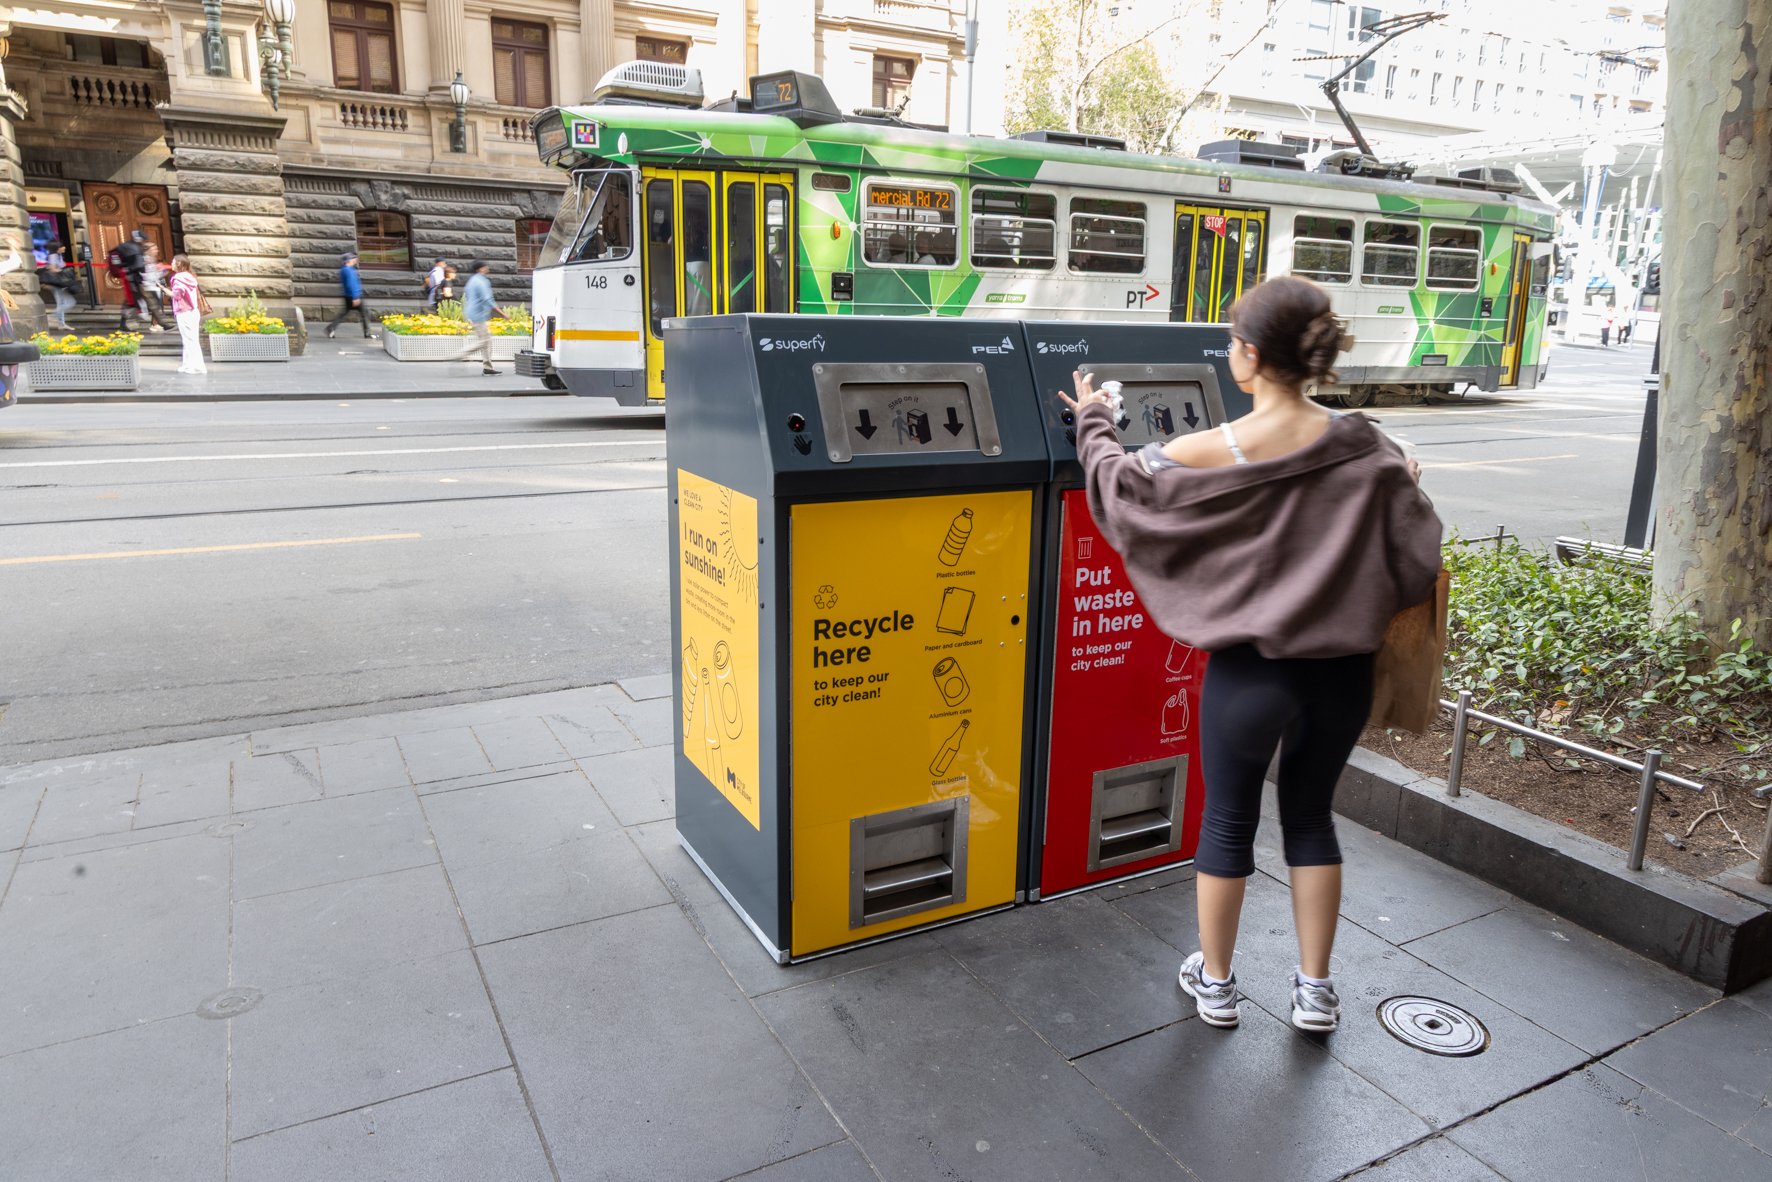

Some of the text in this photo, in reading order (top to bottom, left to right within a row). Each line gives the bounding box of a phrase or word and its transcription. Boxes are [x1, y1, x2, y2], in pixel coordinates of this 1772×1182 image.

[777, 82, 792, 102] 72
[871, 189, 950, 209] mercial Rd 72
[1205, 216, 1224, 228] STOP
[585, 275, 608, 289] 148
[775, 336, 826, 353] superfy
[972, 345, 1009, 354] PEL
[1049, 341, 1089, 355] superfy
[689, 529, 704, 549] run
[706, 538, 718, 558] on
[684, 548, 726, 587] sunshine!
[936, 569, 976, 579] Plastic bottles
[1075, 566, 1112, 588] Put
[1074, 589, 1135, 612] waste
[814, 609, 915, 641] Recycle
[1072, 613, 1144, 637] in here
[924, 644, 941, 652] Paper
[954, 638, 983, 648] cardboard
[1072, 640, 1132, 657] to keep our
[813, 645, 871, 669] here
[1071, 653, 1125, 671] city clean!
[813, 672, 890, 691] to keep our
[814, 687, 881, 707] city clean!
[928, 710, 958, 719] Aluminium
